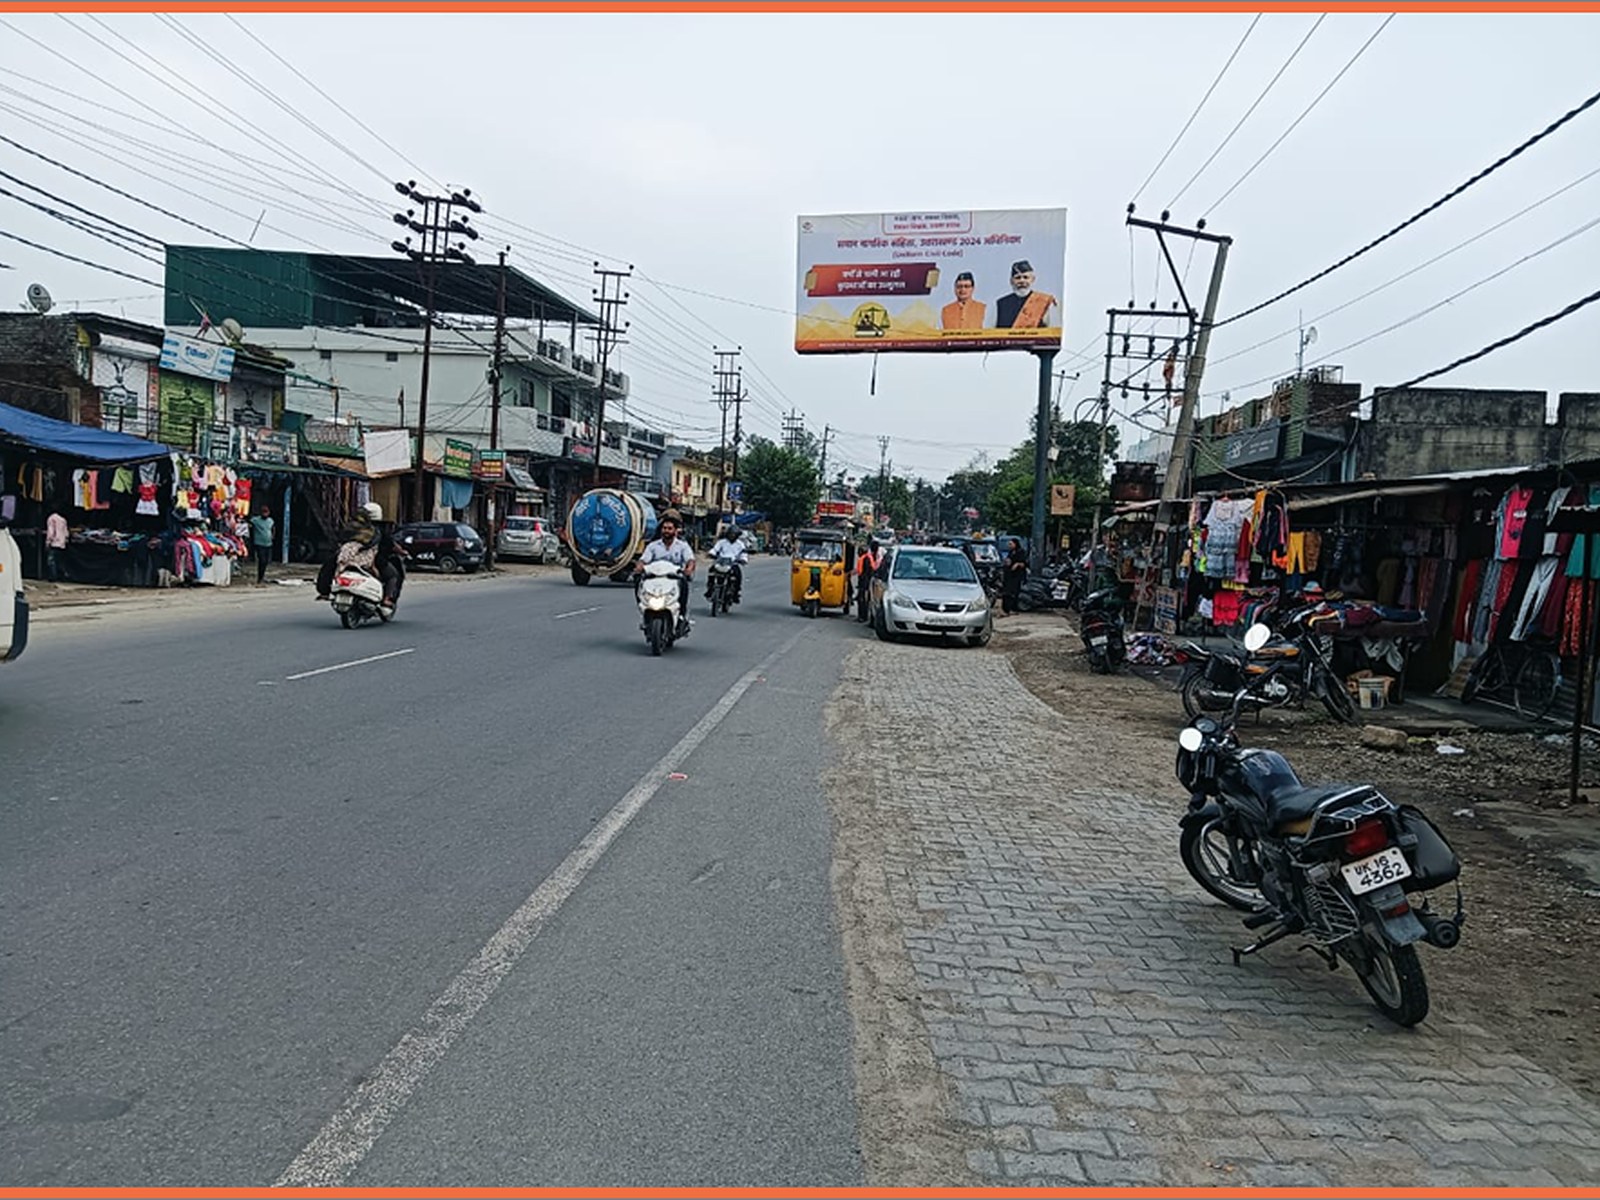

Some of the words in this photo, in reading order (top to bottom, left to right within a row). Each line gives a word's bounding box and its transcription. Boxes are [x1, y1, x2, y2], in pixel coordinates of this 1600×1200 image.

[960, 238, 981, 246] 2024
[1354, 862, 1371, 875] UK
[1373, 856, 1389, 868] 16
[1361, 862, 1404, 886] 4362
